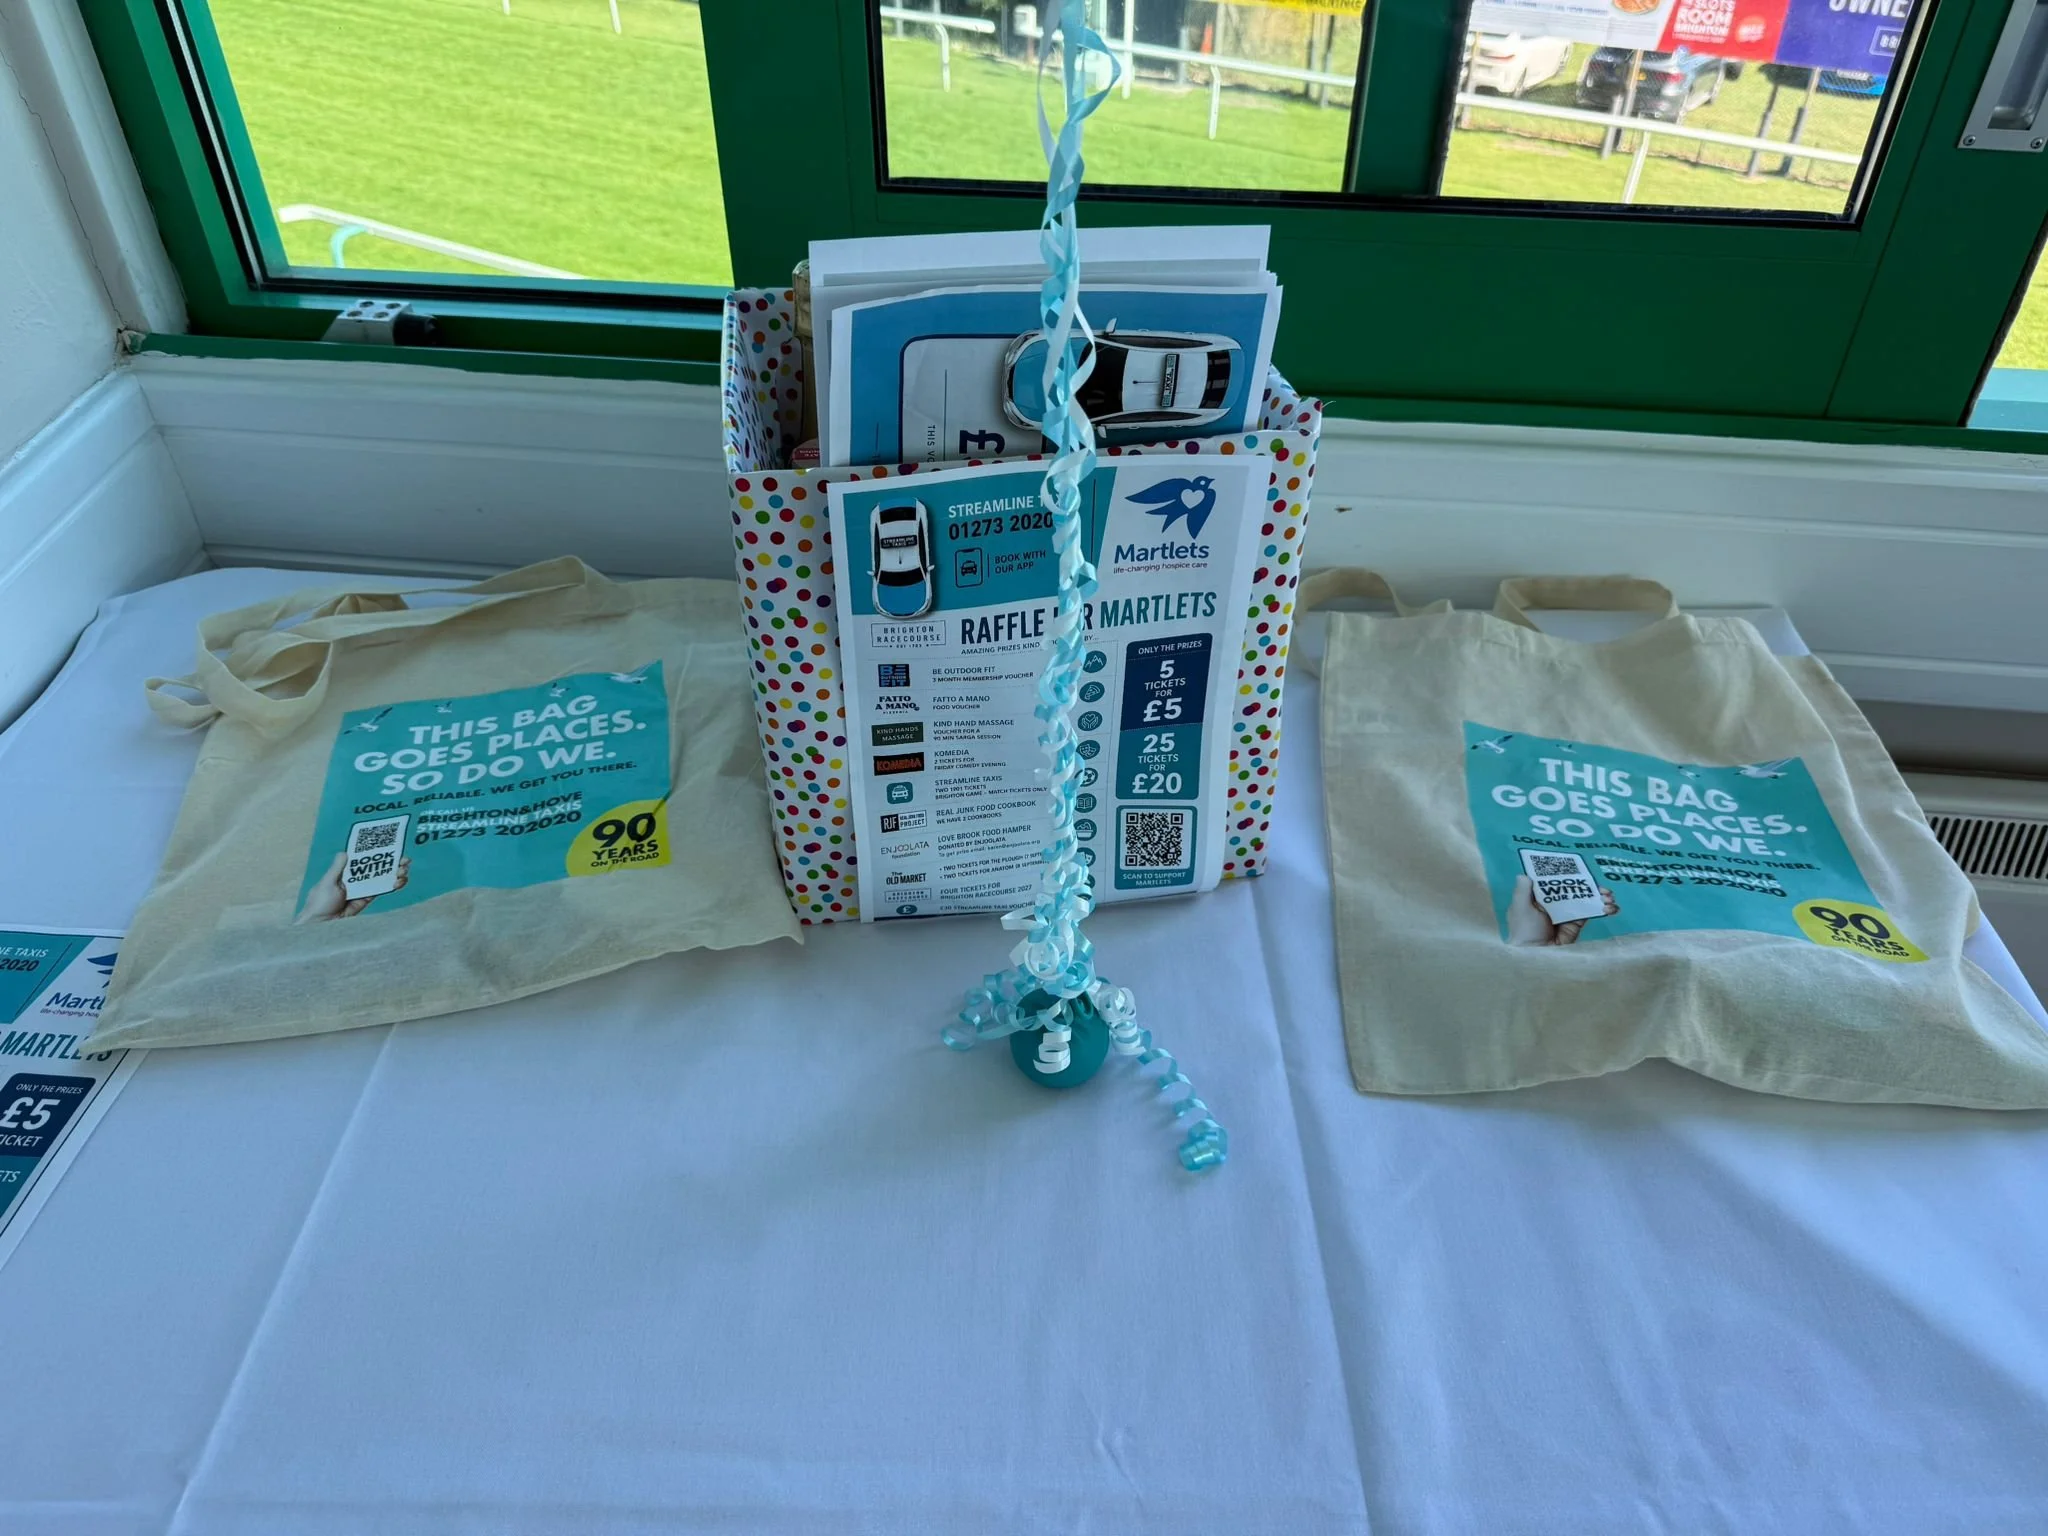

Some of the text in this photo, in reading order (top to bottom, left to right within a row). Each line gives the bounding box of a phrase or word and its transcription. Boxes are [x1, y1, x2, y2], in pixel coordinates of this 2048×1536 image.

[1676, 6, 1734, 27] ROOM
[926, 425, 936, 446] THIS
[948, 496, 1034, 518] STREAMLINE
[949, 512, 1053, 540] 01273 2020
[995, 551, 1046, 564] BOOK WITH
[1114, 542, 1209, 564] Martlets
[995, 562, 1034, 574] OUR APP
[1114, 563, 1160, 574] life-changing
[1162, 562, 1190, 571] hospice
[1100, 592, 1217, 629] MARTLETS
[884, 626, 934, 634] BRIGHTON
[961, 608, 1045, 644] RAFFLE
[876, 634, 941, 642] RACECOURSE
[961, 644, 1021, 655] AMAZING PRIZES
[1138, 640, 1202, 654] ONLY THE PRIZES
[1005, 672, 1034, 680] VOUCHER
[1159, 660, 1174, 678] 5
[1144, 678, 1186, 690] TICKETS
[1155, 689, 1172, 697] FOR
[1143, 698, 1182, 722] £5
[408, 695, 598, 744] THIS BAG
[934, 720, 952, 728] KIND
[354, 710, 647, 772] GOES PLACES.
[1143, 732, 1175, 754] 25
[934, 750, 969, 758] KOMEDIA
[1138, 754, 1179, 764] TICKETS
[380, 741, 616, 794] SO DO WE.
[876, 758, 921, 772] KOMEDIA
[1149, 764, 1166, 772] FOR
[354, 761, 637, 814] LOCAL. RELIABLE. WE GET YOU THERE.
[935, 776, 980, 786] STREAMLINE
[1132, 772, 1182, 794] £20
[1539, 758, 1738, 812] THIS BAG
[936, 791, 964, 800] BRIGHTON
[418, 792, 583, 824] BRIGHTON&HOVE
[936, 800, 1036, 816] REAL JUNK FOOD COOKBOOK
[968, 812, 1002, 820] COOKBOOKS
[1491, 784, 1808, 835] GOES PLACES.
[416, 801, 582, 833] STREAMLINE TAXIS
[883, 816, 896, 830] RJF
[900, 819, 924, 828] PROJECT
[415, 811, 582, 845] 01273 202020
[592, 812, 656, 848] 90
[938, 825, 1032, 843] LOVE BROOK FOOD HAMPER
[1529, 814, 1786, 856] SO DO WE.
[592, 840, 658, 860] YEARS
[880, 841, 930, 854] ENJOOLATA
[938, 837, 1006, 851] DONATED ENJOOLATA
[1512, 834, 1570, 849] LOCAL.
[1655, 848, 1682, 858] WE
[1688, 851, 1718, 861] GET
[1722, 855, 1760, 866] YOU
[1762, 860, 1821, 870] THERE.
[350, 850, 395, 868] BOOK
[590, 860, 608, 868] ON
[630, 852, 660, 862] ROAD
[348, 868, 392, 884] OUR APP
[350, 859, 394, 878] WITH
[1595, 858, 1776, 880] BRIGHTON&HOVE
[886, 873, 926, 884] OLD MARKET
[1538, 878, 1588, 888] BOOK
[1604, 872, 1787, 898] 01273 202020
[1722, 874, 1782, 889] TAXIS
[975, 888, 1016, 898] RACECOURSE
[1541, 886, 1593, 896] WITH
[1544, 892, 1594, 904] OUR APP
[1809, 906, 1890, 940] 90
[1824, 924, 1904, 952] YEARS
[16, 948, 49, 958] TAXIS
[1875, 948, 1910, 958] ROAD
[0, 958, 40, 972] 2020
[46, 992, 106, 1010] Martl
[16, 1084, 38, 1092] ONLY
[56, 1086, 84, 1094] PRIZES
[0, 1096, 60, 1130] £5
